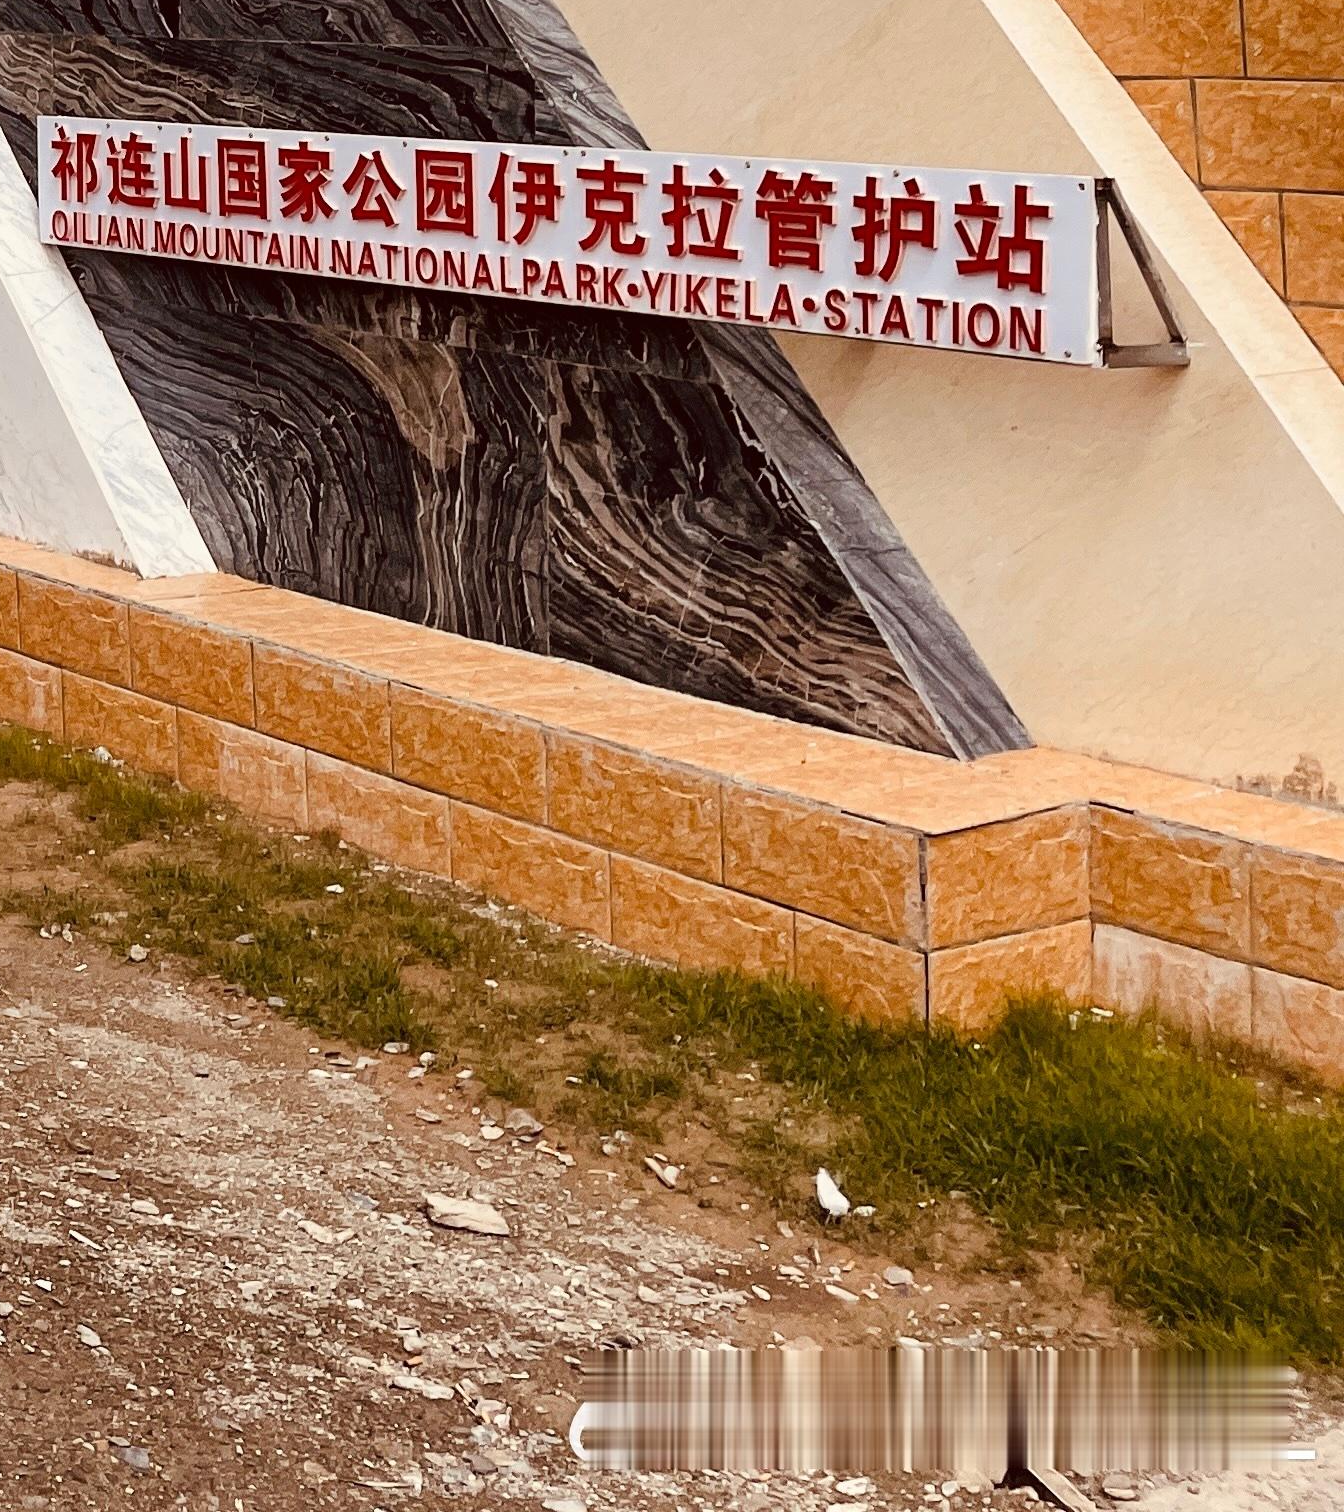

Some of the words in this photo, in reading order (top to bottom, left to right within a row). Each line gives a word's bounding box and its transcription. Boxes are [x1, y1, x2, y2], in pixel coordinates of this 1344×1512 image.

[50, 125, 1051, 294] 祁连山国家公园伊克拉管护站
[51, 209, 145, 252] QILIAN
[153, 221, 320, 272] MOUNTAIN
